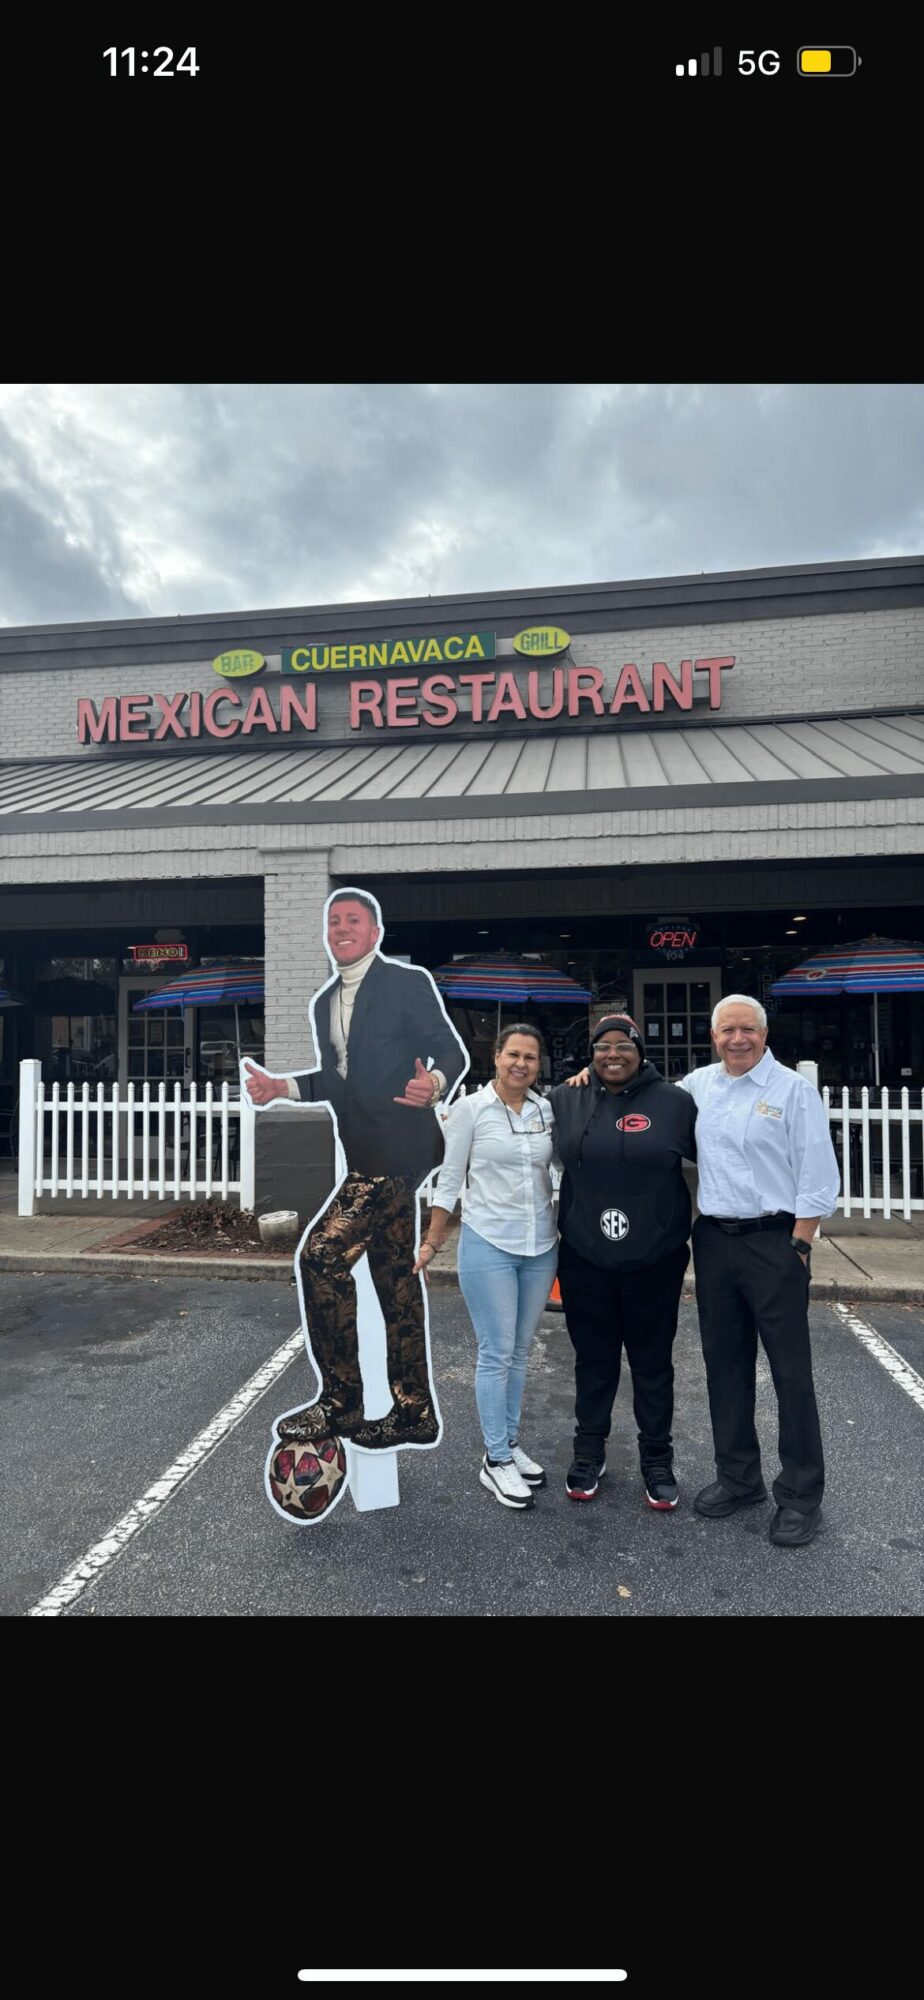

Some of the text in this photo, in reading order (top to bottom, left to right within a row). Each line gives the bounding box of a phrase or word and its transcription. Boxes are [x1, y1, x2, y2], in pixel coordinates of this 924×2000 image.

[290, 634, 486, 672] CUERNAVACA
[519, 630, 564, 653] GRILL
[220, 653, 255, 673] BAR
[77, 656, 736, 744] MEXICAN RESTAURANT
[650, 931, 697, 948] OPEN
[664, 952, 685, 961] 104
[603, 1211, 627, 1239] SEC
